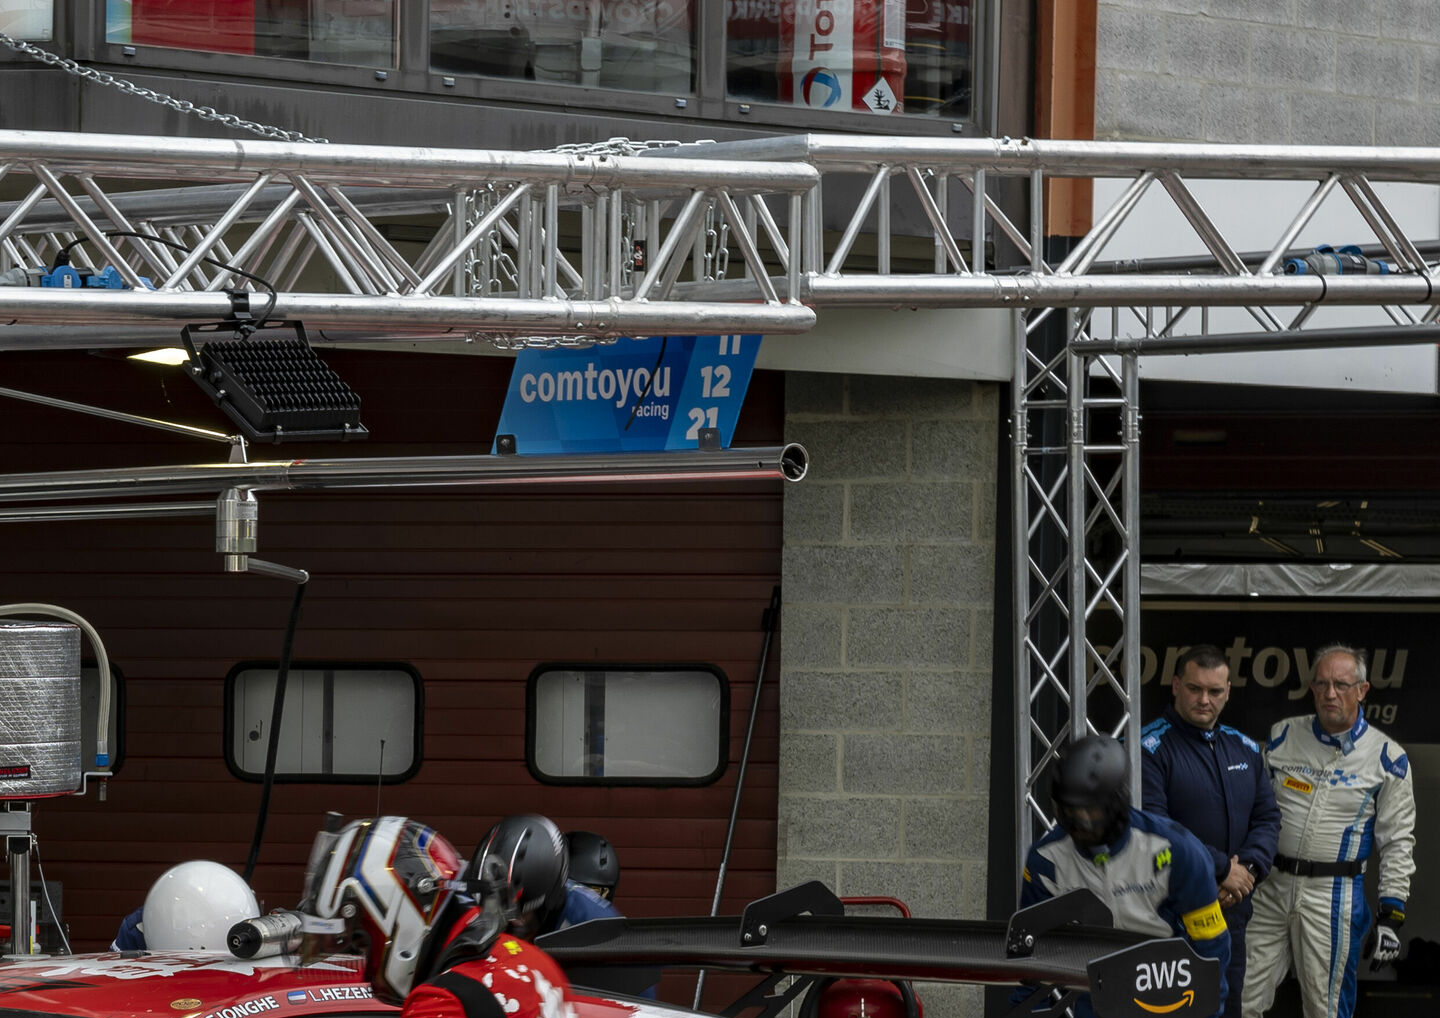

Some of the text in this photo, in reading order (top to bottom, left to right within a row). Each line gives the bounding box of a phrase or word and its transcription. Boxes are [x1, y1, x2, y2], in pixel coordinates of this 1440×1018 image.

[810, 0, 834, 61] TO
[520, 362, 671, 408] comtoyou
[701, 365, 732, 398] 12
[631, 402, 670, 420] racing
[685, 407, 719, 440] 21
[1135, 959, 1192, 992] aws
